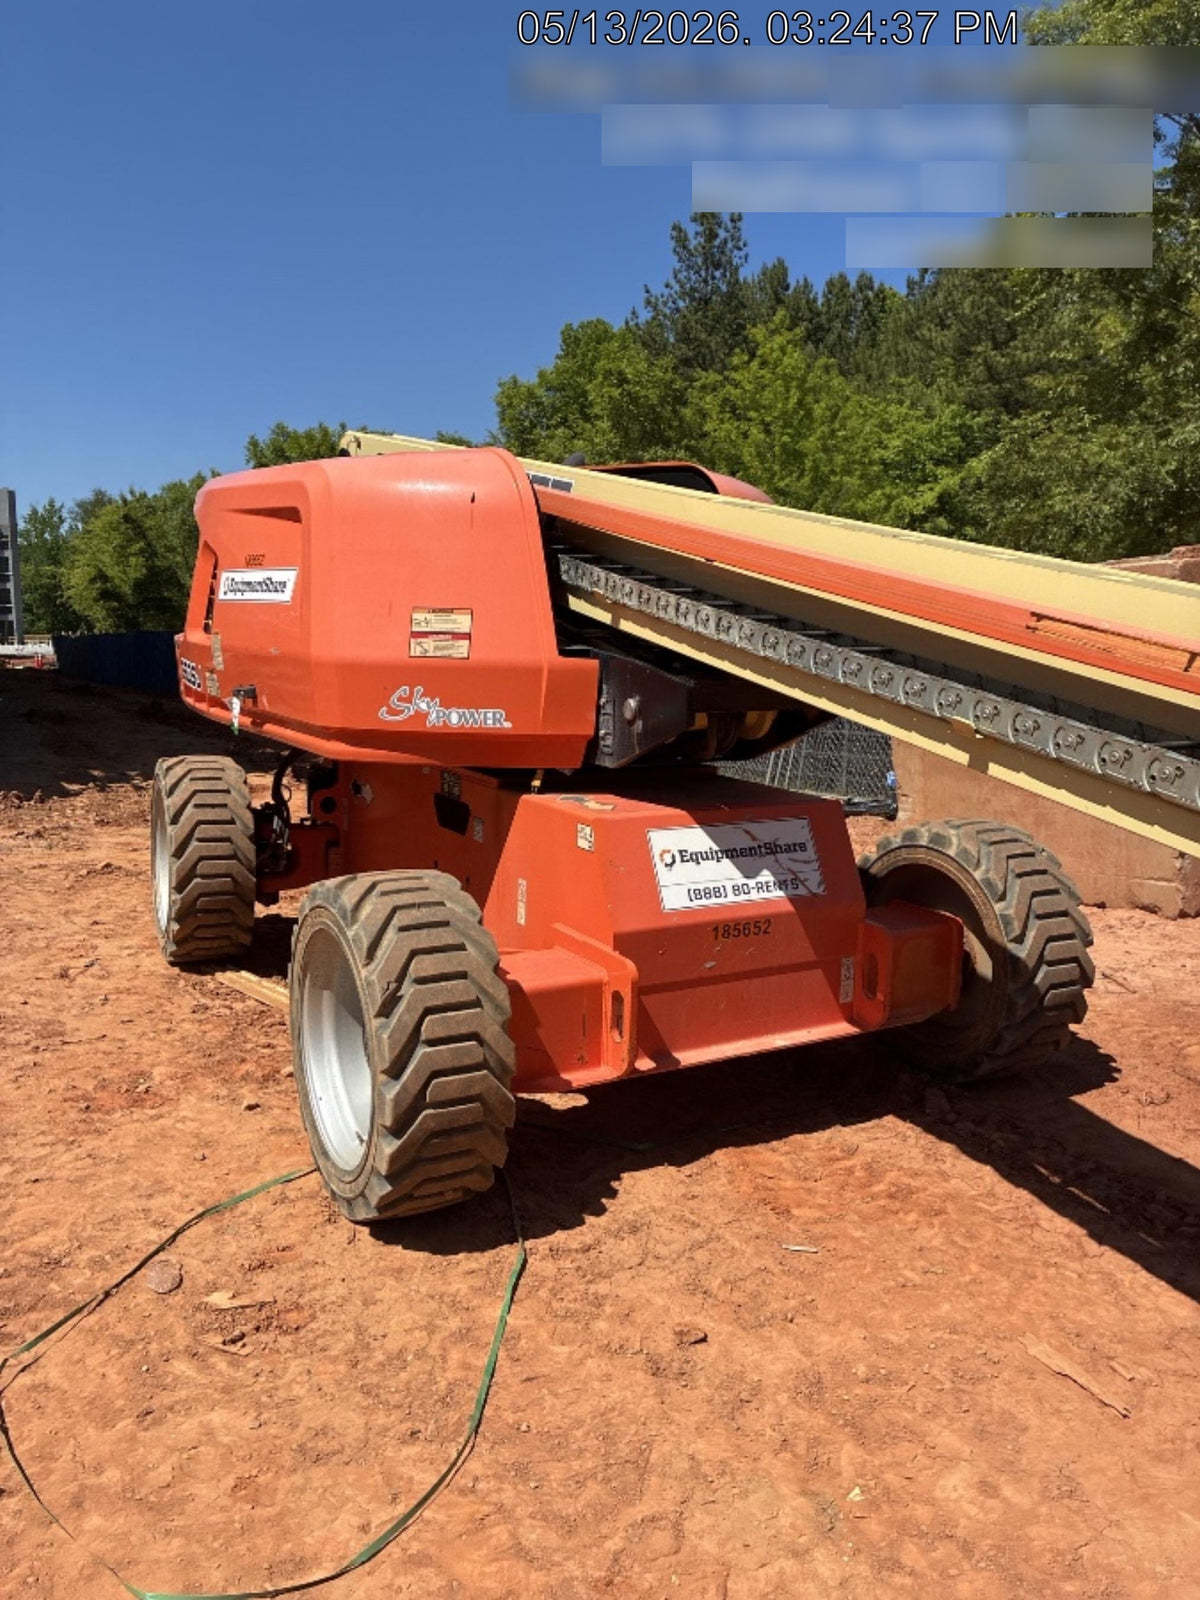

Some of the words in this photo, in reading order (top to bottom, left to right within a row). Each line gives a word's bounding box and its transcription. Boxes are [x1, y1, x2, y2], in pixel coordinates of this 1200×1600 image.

[433, 708, 506, 728] POWER
[679, 840, 808, 865] EquipmentShare
[712, 919, 773, 940] 185652
